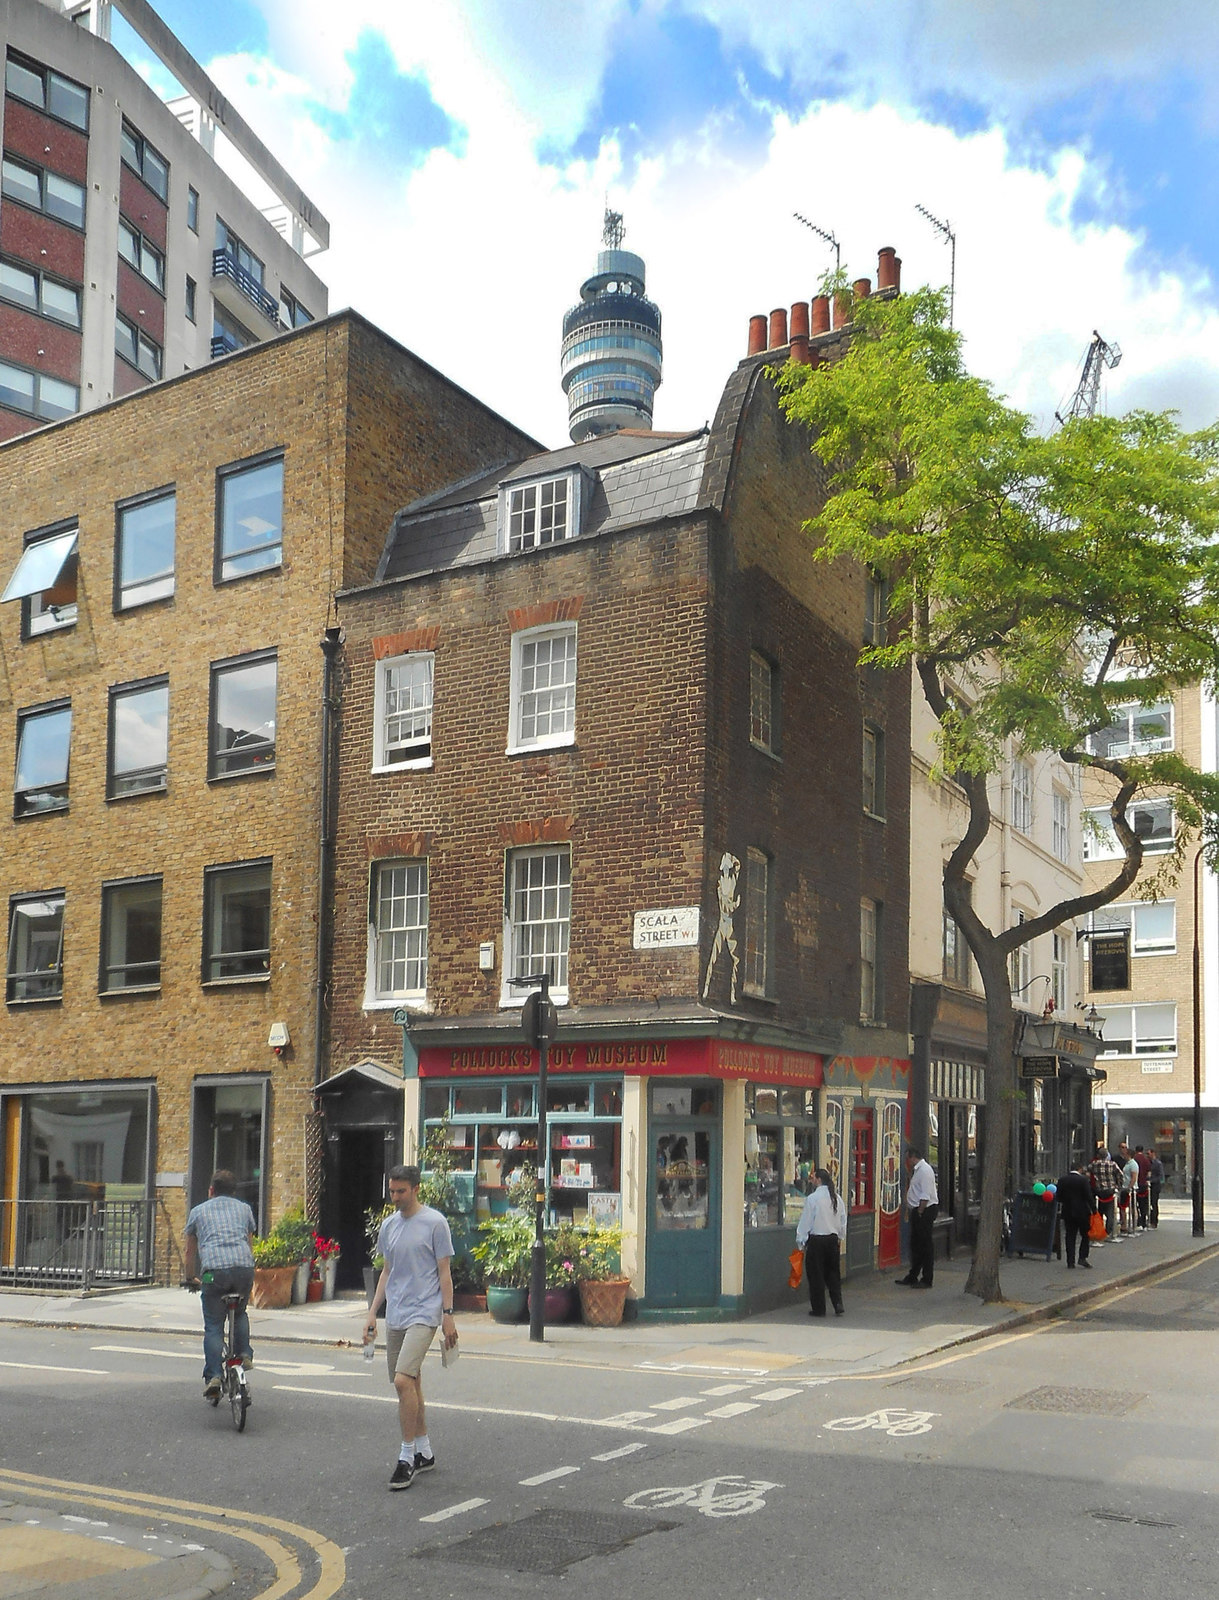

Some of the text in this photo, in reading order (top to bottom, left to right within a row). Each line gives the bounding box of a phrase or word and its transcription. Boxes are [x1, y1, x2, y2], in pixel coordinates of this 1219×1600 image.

[640, 915, 678, 927] SCALA
[640, 929, 694, 941] STREET W1
[450, 1047, 532, 1071] POLLOCK'S
[585, 1043, 668, 1068] MUSEUM
[763, 1052, 780, 1075] TOY
